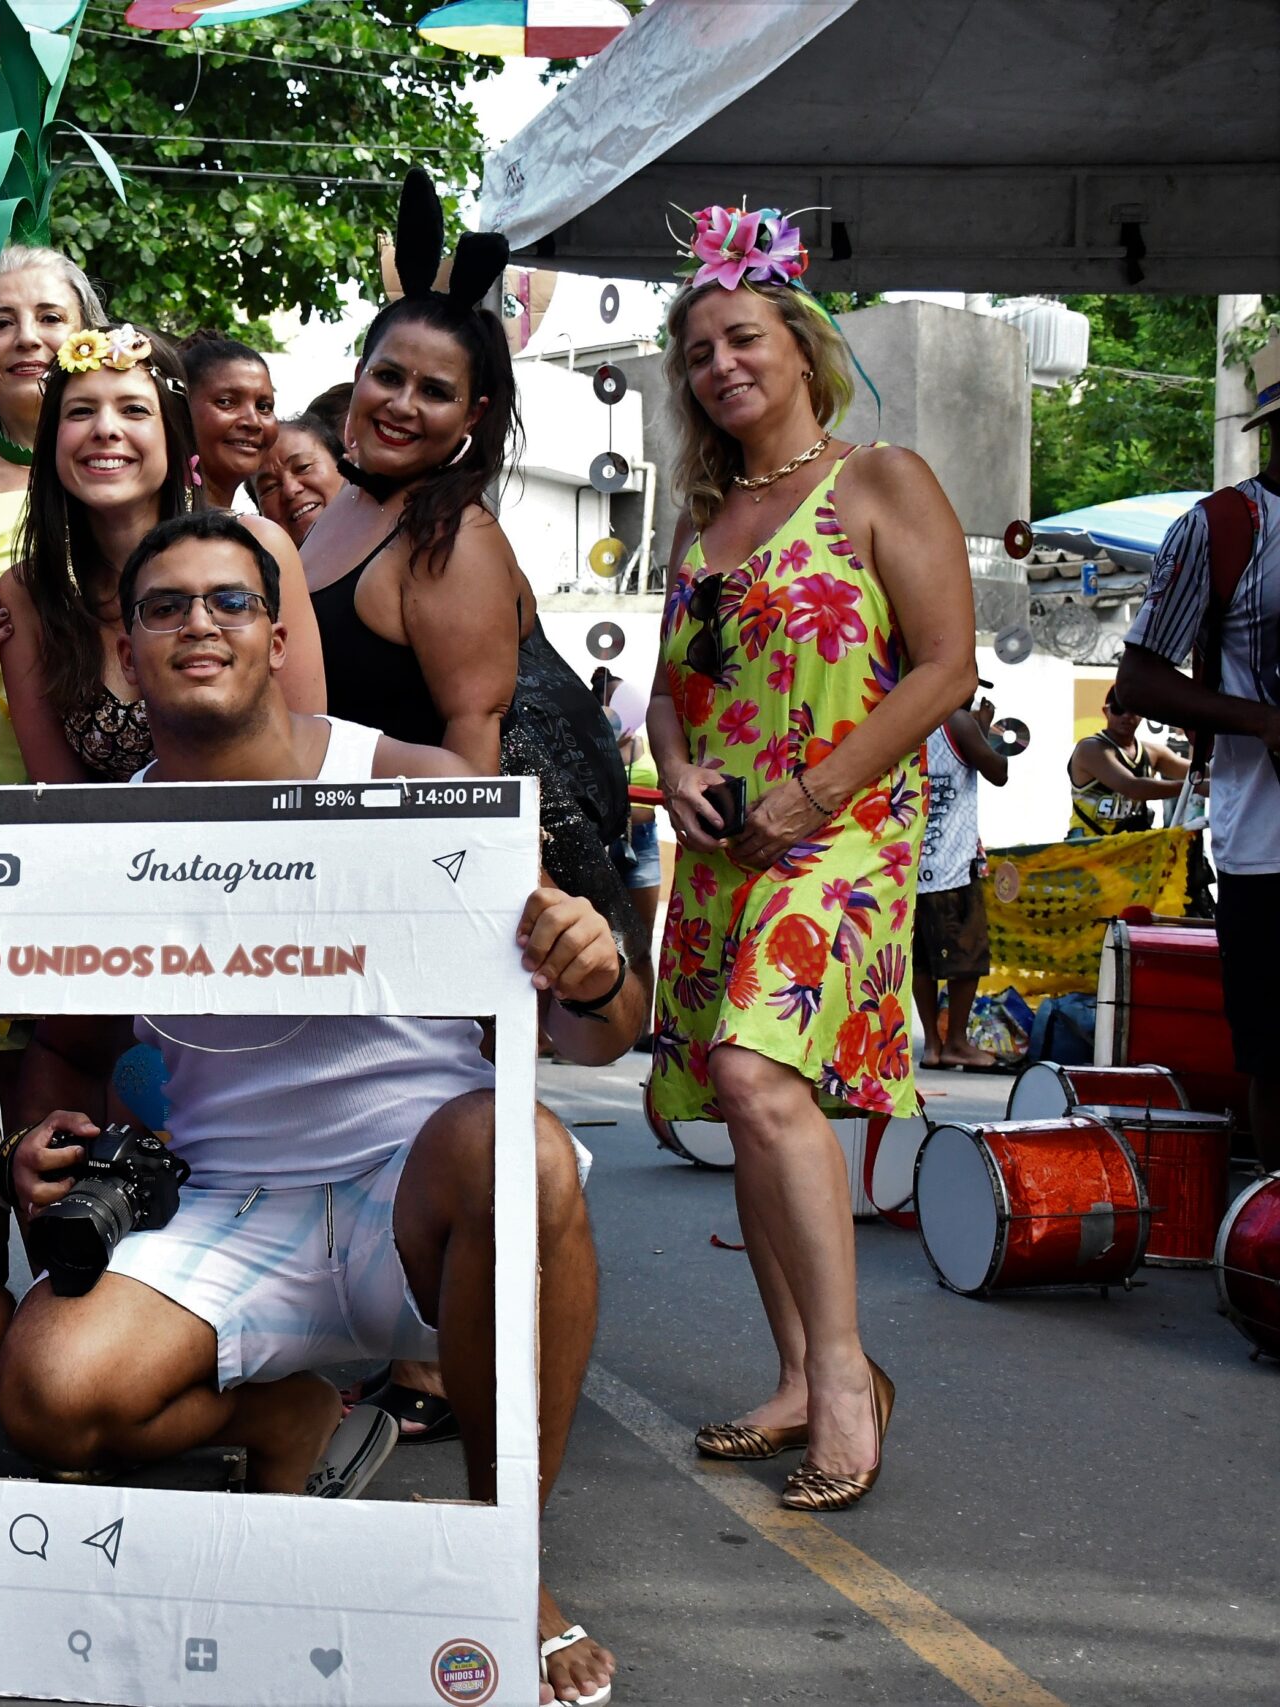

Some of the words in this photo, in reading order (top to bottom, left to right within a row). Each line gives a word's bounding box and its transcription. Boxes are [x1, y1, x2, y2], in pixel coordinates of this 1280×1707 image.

[314, 790, 355, 806] 98%
[415, 788, 468, 805] 14:00
[472, 787, 502, 804] PM
[127, 848, 317, 893] Instagram
[7, 944, 155, 978] UNIDOS
[161, 943, 215, 977] DA
[223, 943, 367, 978] ASCLIN
[88, 1160, 111, 1168] Nikon
[444, 1670, 473, 1681] UNIDOS
[475, 1669, 485, 1679] DA
